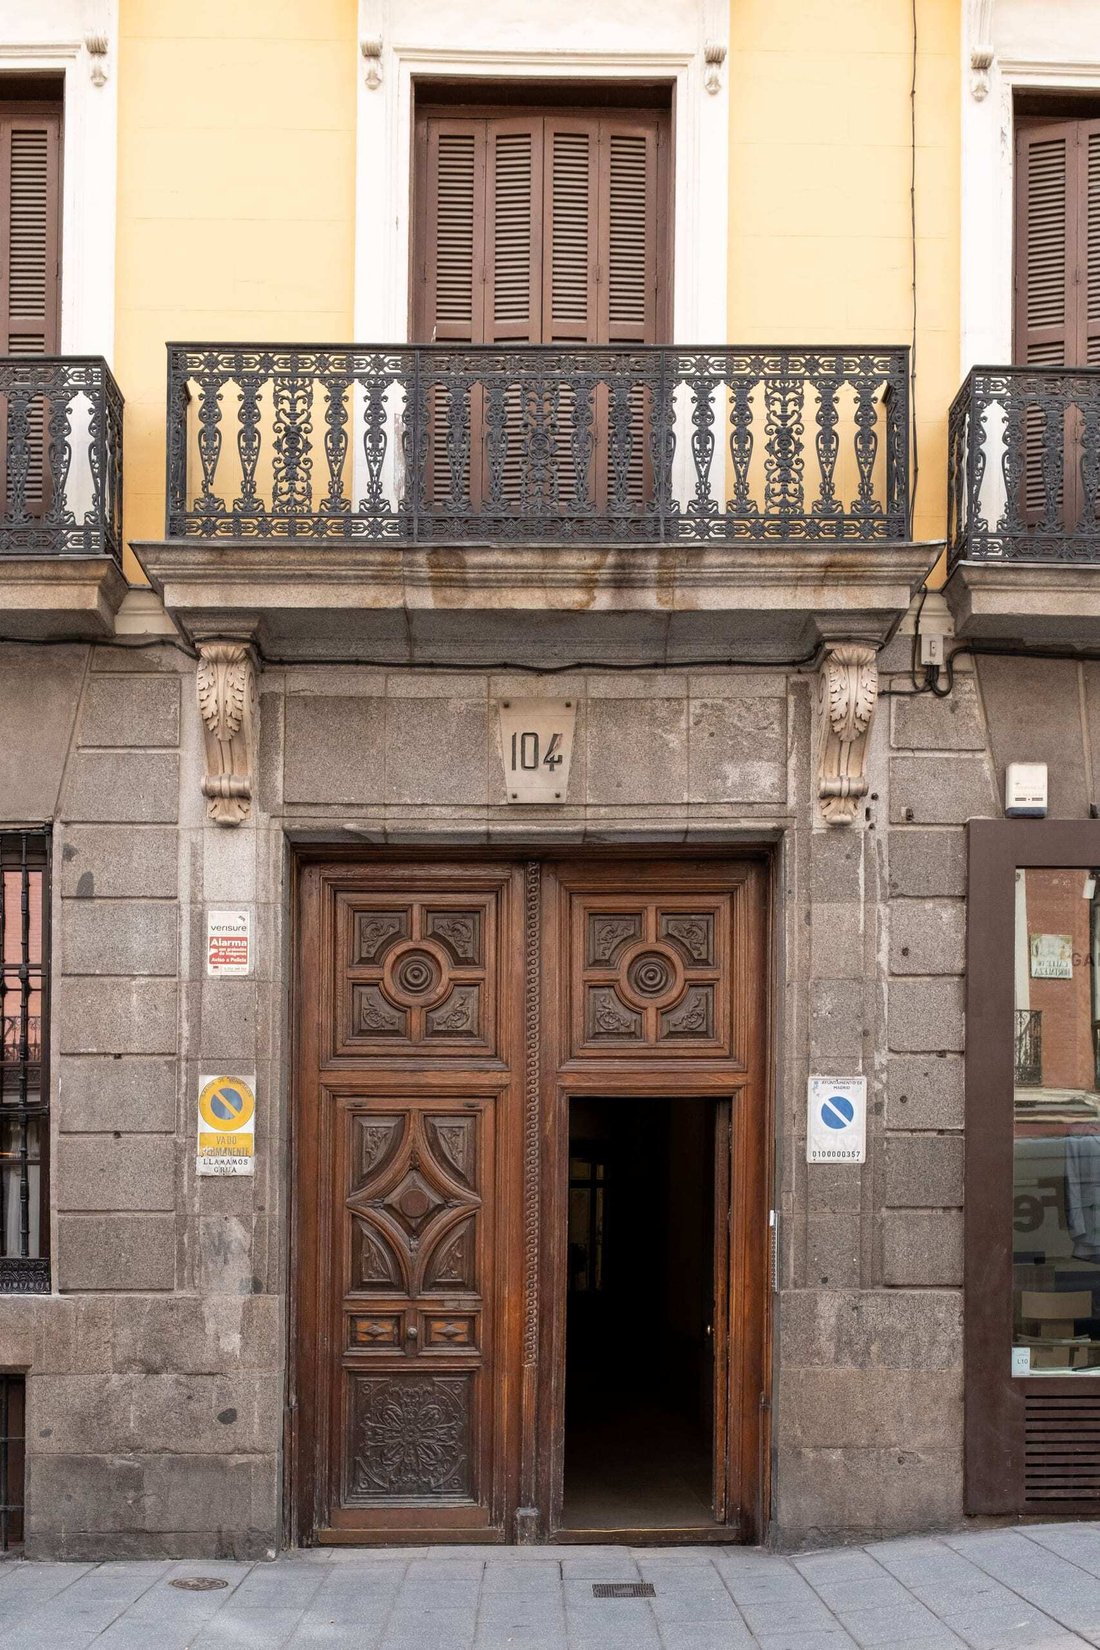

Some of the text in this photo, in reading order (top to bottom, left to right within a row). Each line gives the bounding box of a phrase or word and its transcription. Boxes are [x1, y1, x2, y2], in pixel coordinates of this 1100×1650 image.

[511, 732, 563, 771] 104
[211, 938, 247, 946] Alarma
[1072, 953, 1100, 966] GA
[216, 1136, 237, 1145] VADO
[203, 1158, 248, 1166] LLAMAMOS
[213, 1166, 237, 1174] GRUA
